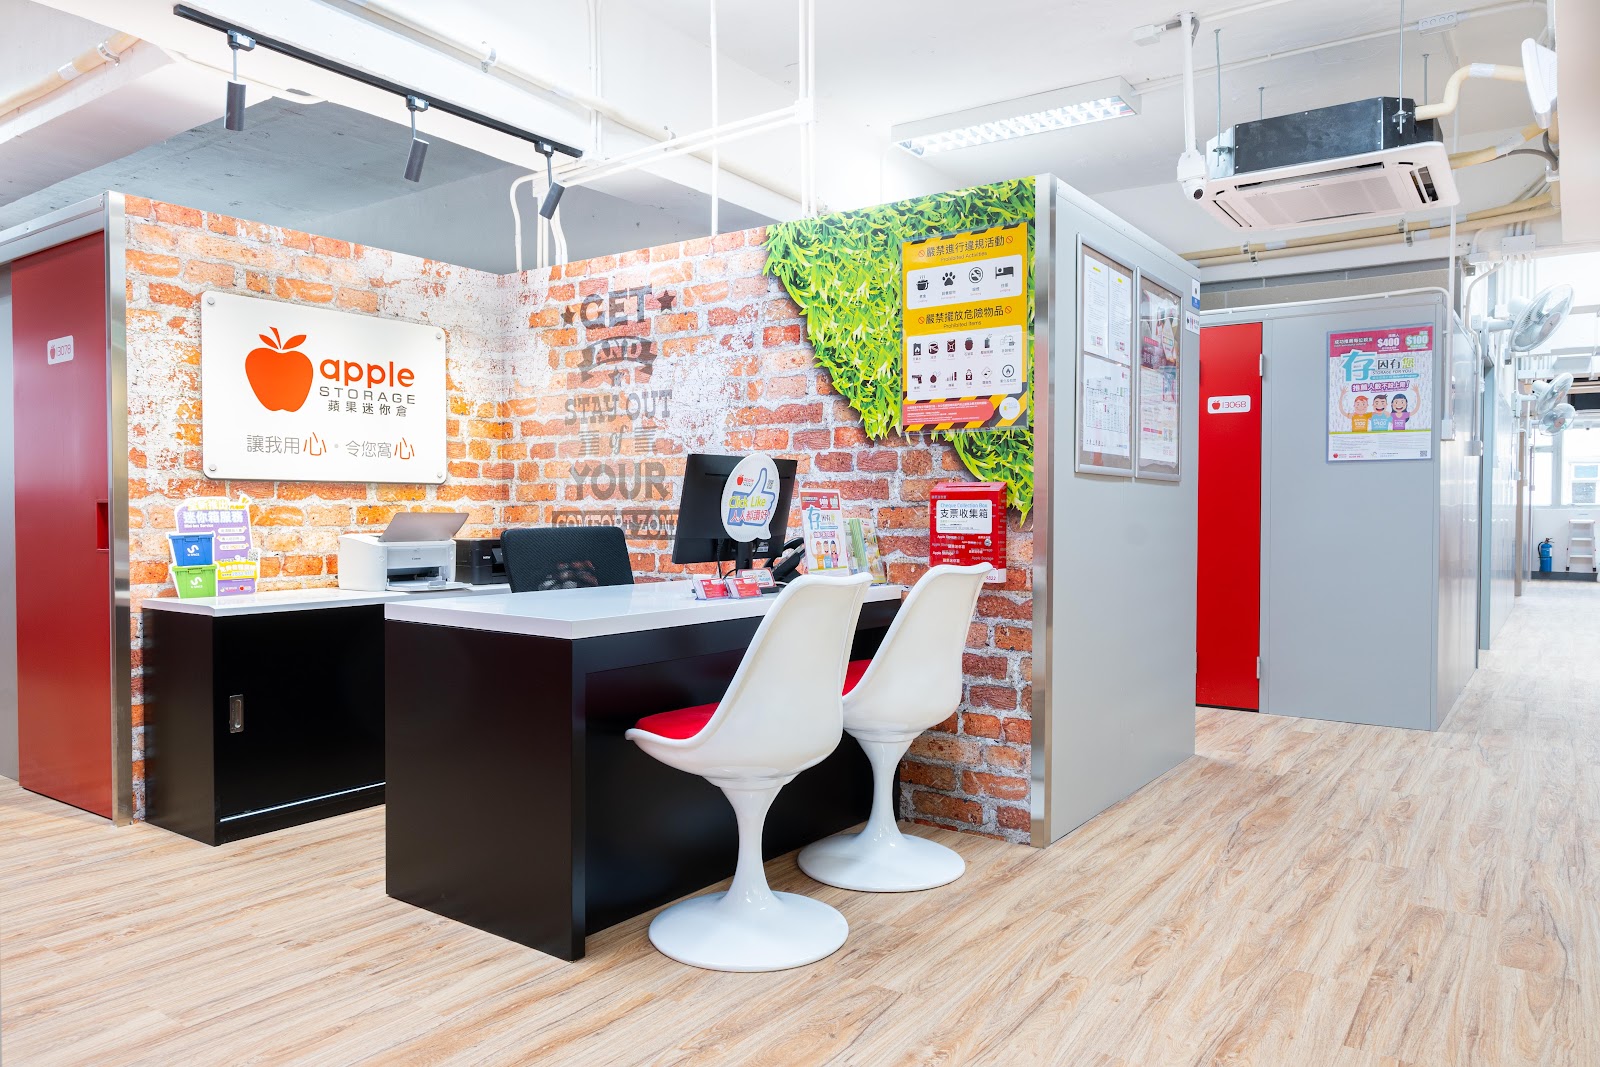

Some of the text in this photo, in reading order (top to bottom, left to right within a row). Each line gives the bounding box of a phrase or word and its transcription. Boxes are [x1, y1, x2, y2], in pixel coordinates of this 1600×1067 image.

[580, 283, 652, 330] GET
[1377, 337, 1400, 348] $400
[1406, 335, 1429, 345] $100
[319, 358, 415, 389] apple
[319, 385, 416, 405] STORAGE
[327, 399, 408, 418] 蘋果迷你倉
[565, 389, 673, 425] STAY OUT
[246, 431, 415, 460] 讓我用心 令您窩心
[568, 461, 670, 501] YOUR
[729, 495, 766, 508] Click Like
[940, 508, 988, 519] 支票收集箱
